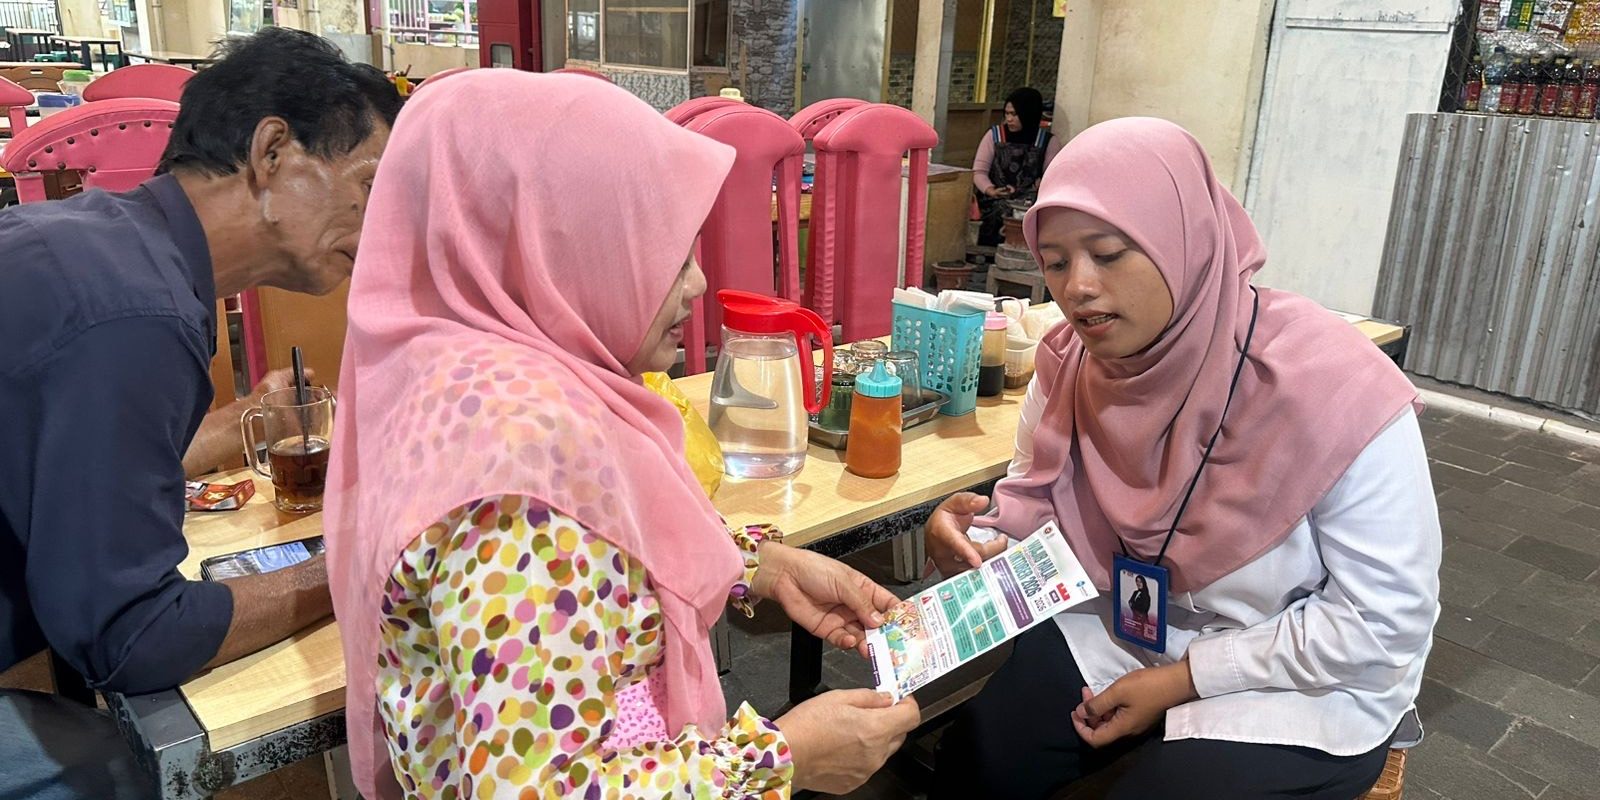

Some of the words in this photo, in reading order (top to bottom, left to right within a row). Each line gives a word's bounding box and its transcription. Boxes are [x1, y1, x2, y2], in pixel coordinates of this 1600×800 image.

[1027, 539, 1048, 563] WAJIB
[1008, 550, 1033, 580] OKTOBER
[1021, 576, 1042, 597] 2026
[1037, 558, 1059, 582] HALAL
[1034, 596, 1047, 611] 2026
